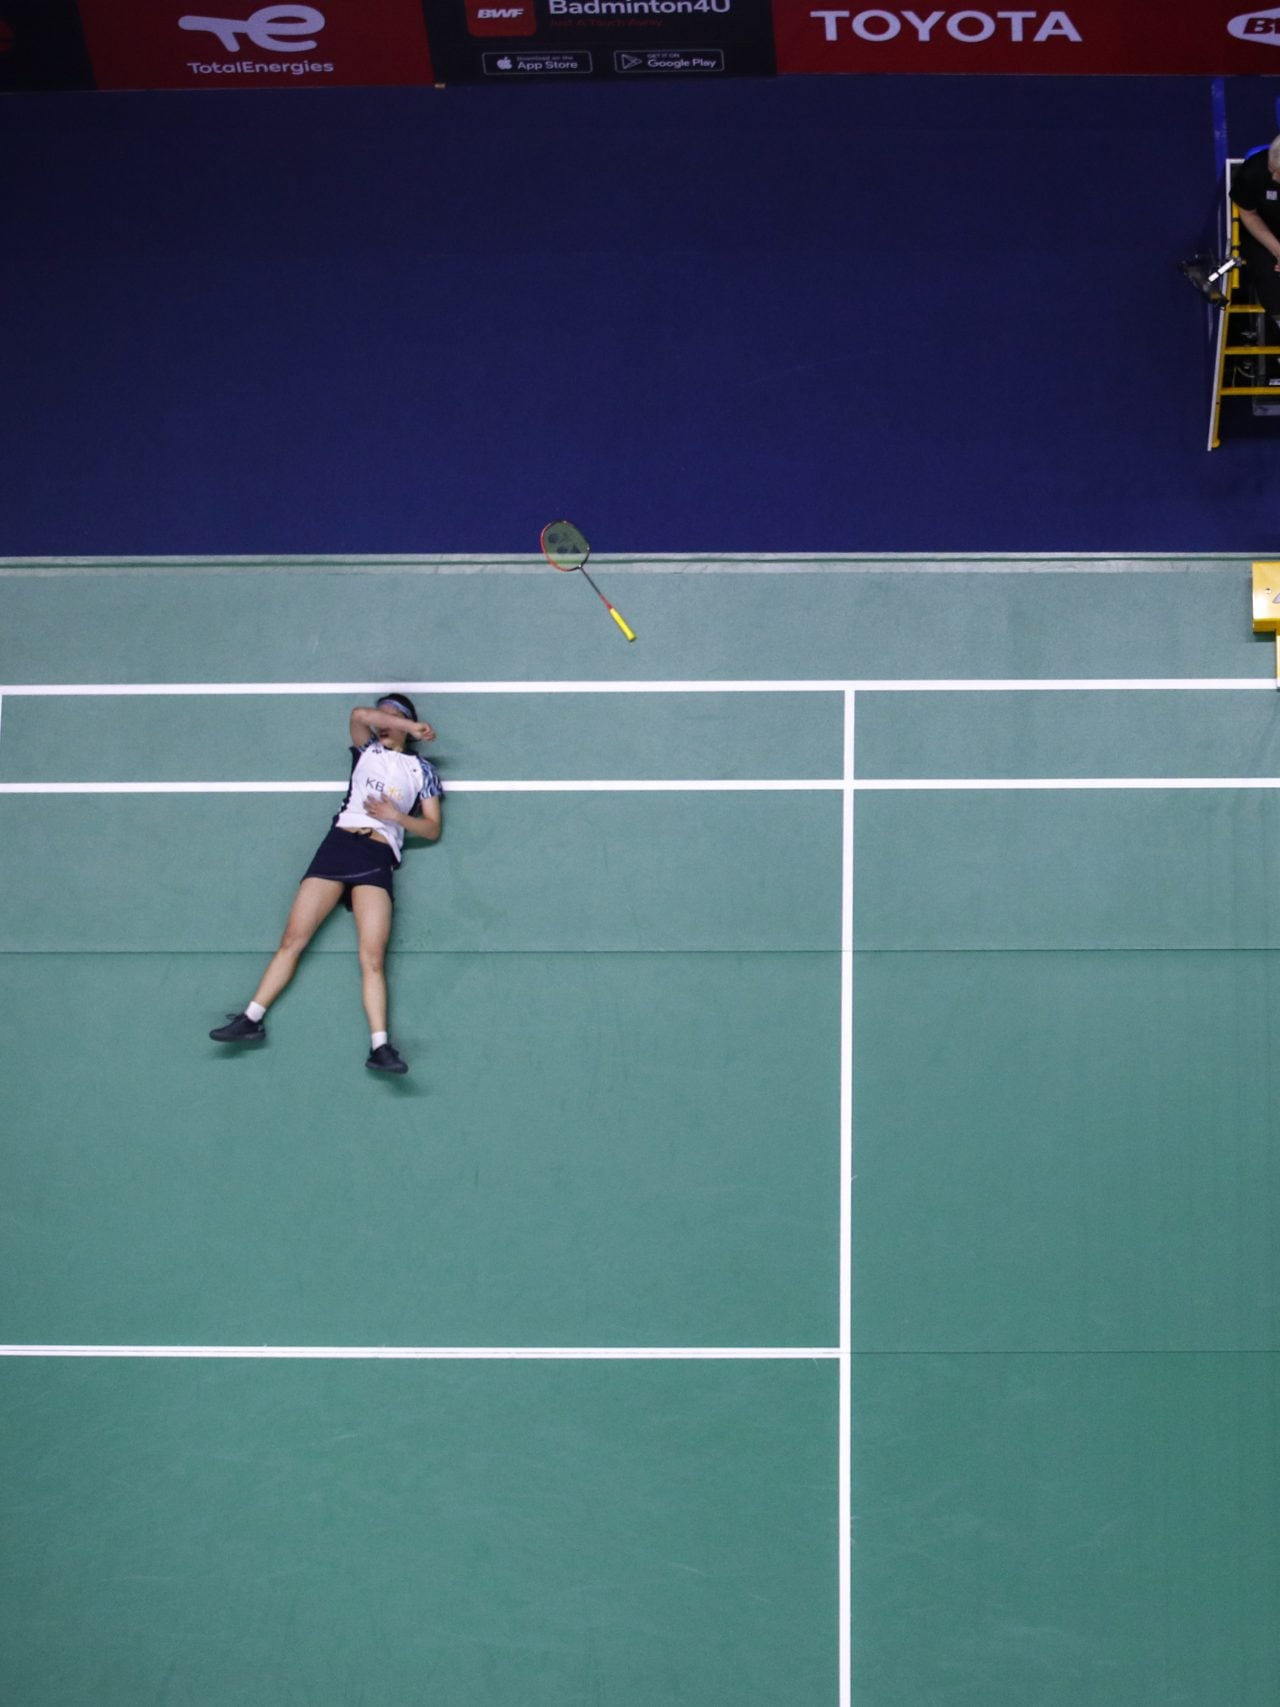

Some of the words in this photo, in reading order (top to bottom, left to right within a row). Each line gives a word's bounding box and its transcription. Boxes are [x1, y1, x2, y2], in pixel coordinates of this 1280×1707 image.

[477, 8, 525, 19] BWF
[549, 0, 731, 15] Badminton4U
[810, 10, 1083, 43] TOYOTA
[187, 60, 335, 75] TotalEnergies
[517, 61, 543, 71] App
[545, 61, 578, 70] Store
[647, 58, 690, 69] Google
[692, 58, 716, 69] Play
[365, 776, 386, 793] KB
